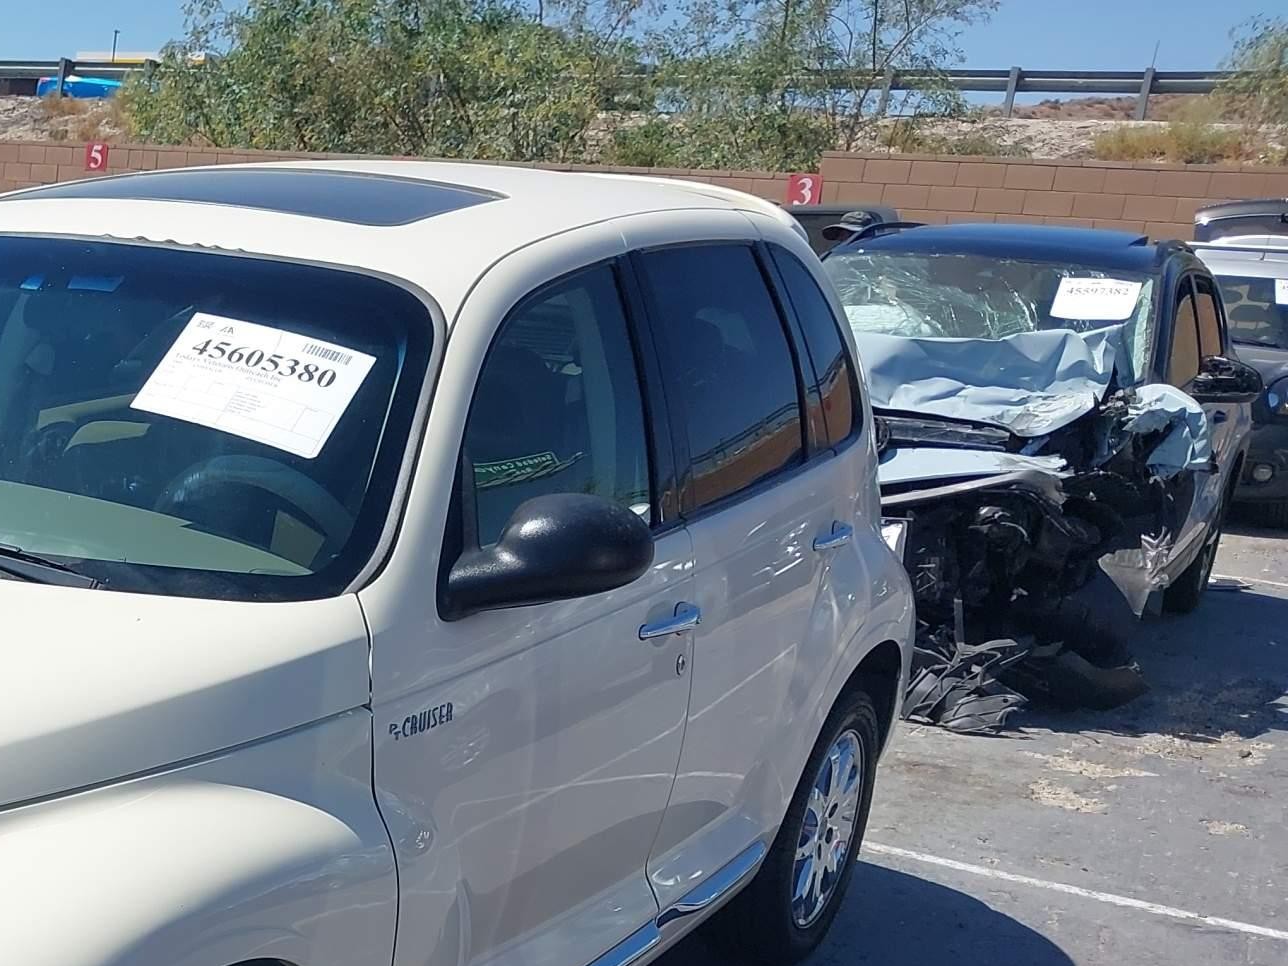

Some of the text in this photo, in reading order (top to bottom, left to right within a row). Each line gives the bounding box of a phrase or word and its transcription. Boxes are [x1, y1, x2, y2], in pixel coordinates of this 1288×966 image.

[89, 144, 103, 169] 5
[792, 177, 813, 205] 3
[192, 338, 337, 389] 45605380
[388, 702, 454, 741] PT CRUISER
